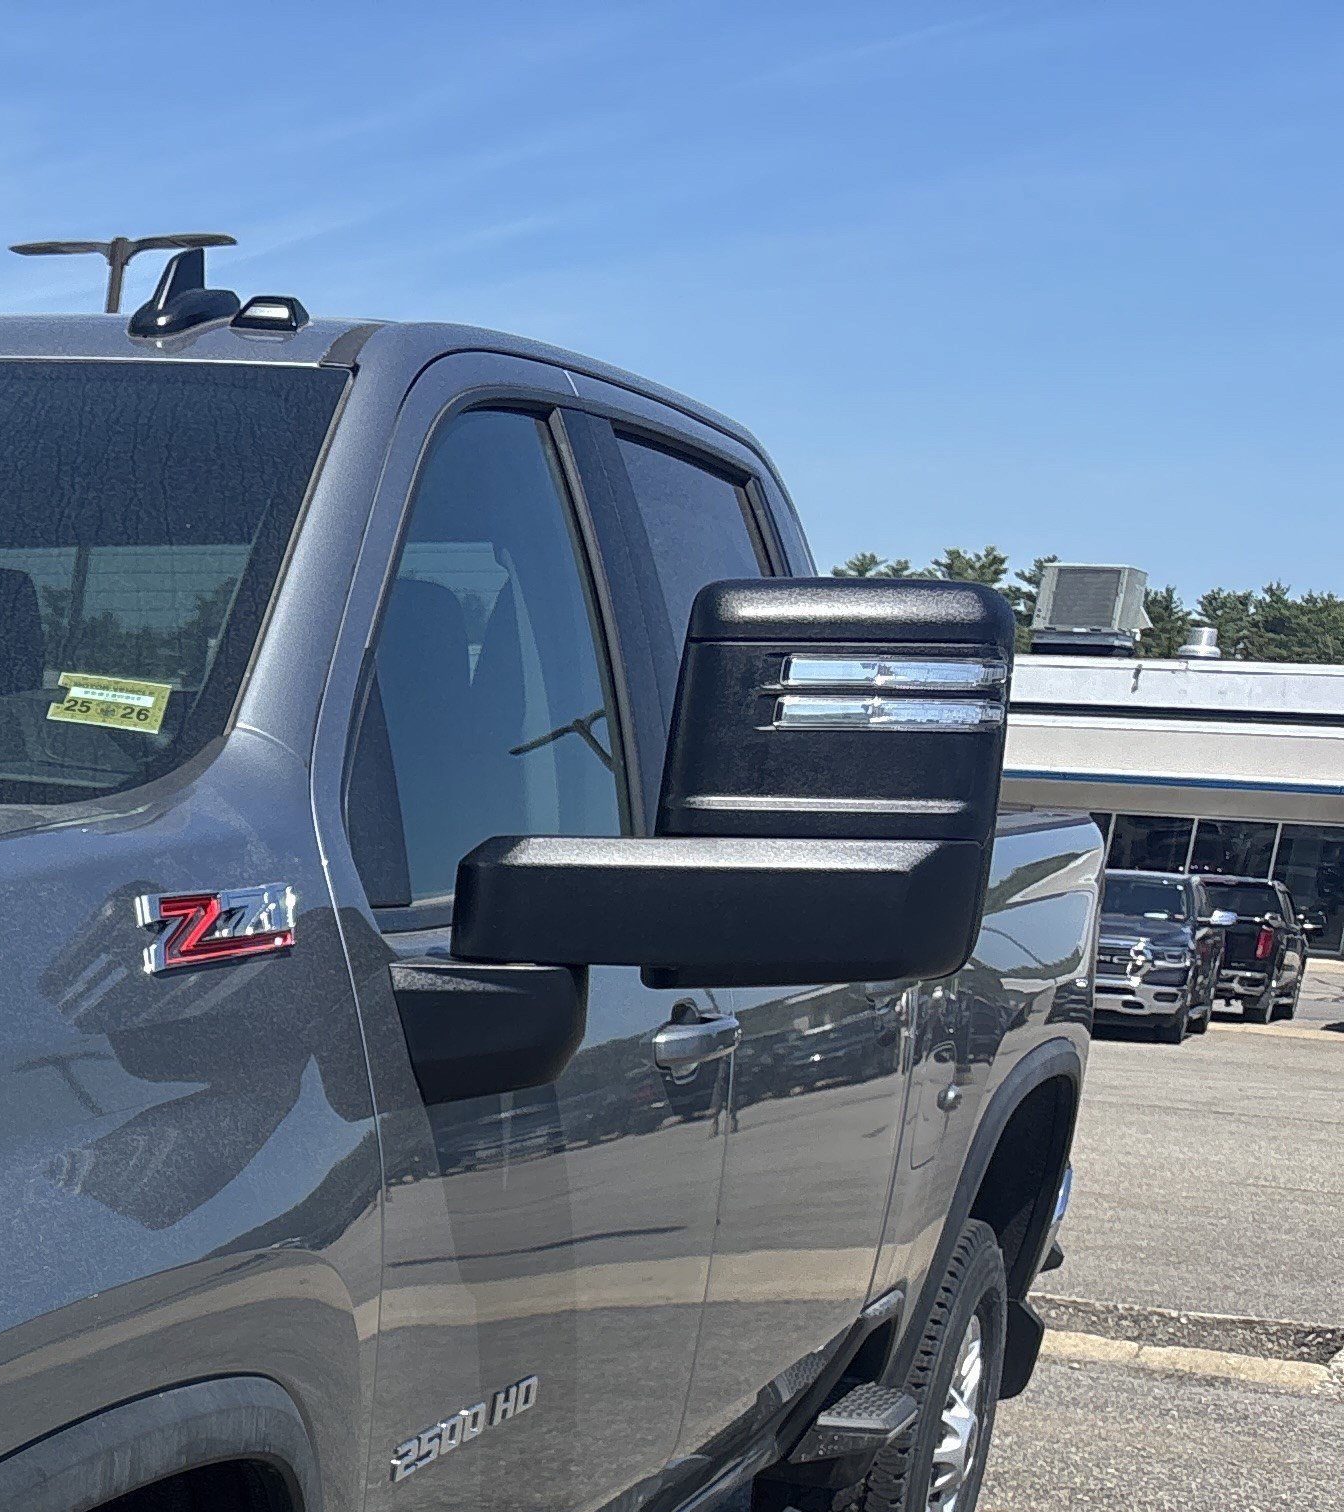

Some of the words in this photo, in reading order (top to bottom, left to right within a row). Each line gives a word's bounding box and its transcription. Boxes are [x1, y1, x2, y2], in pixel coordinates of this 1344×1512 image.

[63, 698, 93, 714] 25
[119, 705, 151, 722] 26
[134, 882, 297, 975] Z71
[389, 1400, 487, 1484] 2500
[489, 1374, 539, 1427] HD
